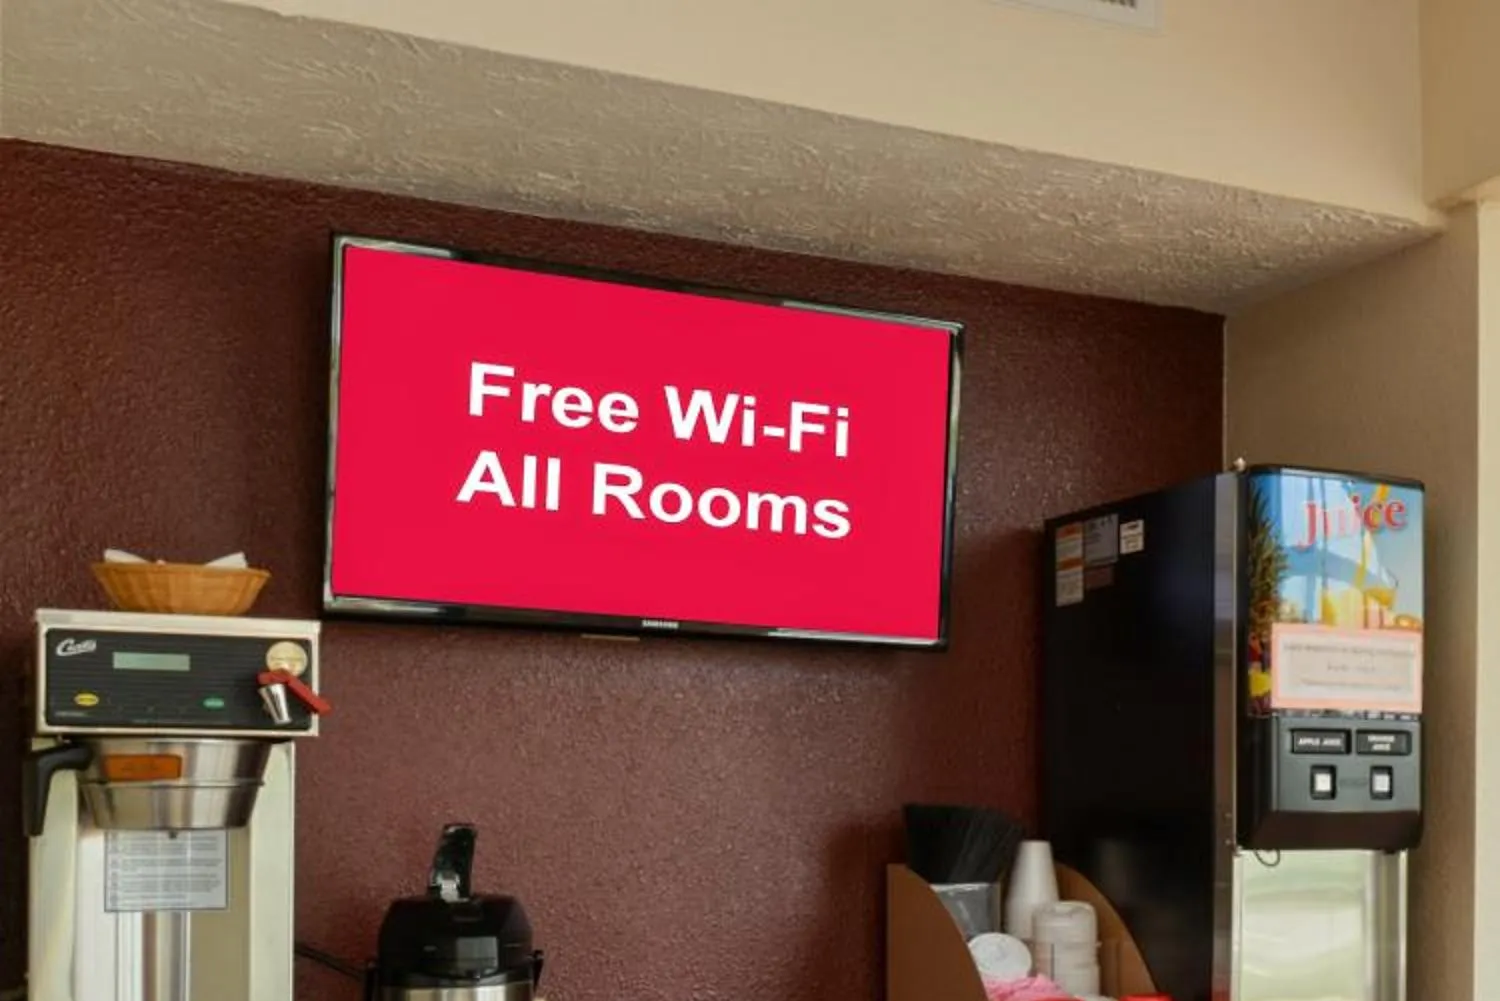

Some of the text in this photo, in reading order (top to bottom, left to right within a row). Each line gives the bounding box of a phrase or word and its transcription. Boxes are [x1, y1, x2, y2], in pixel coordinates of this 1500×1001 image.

[468, 360, 850, 458] Free Wi-Fi
[455, 449, 852, 540] All Rooms
